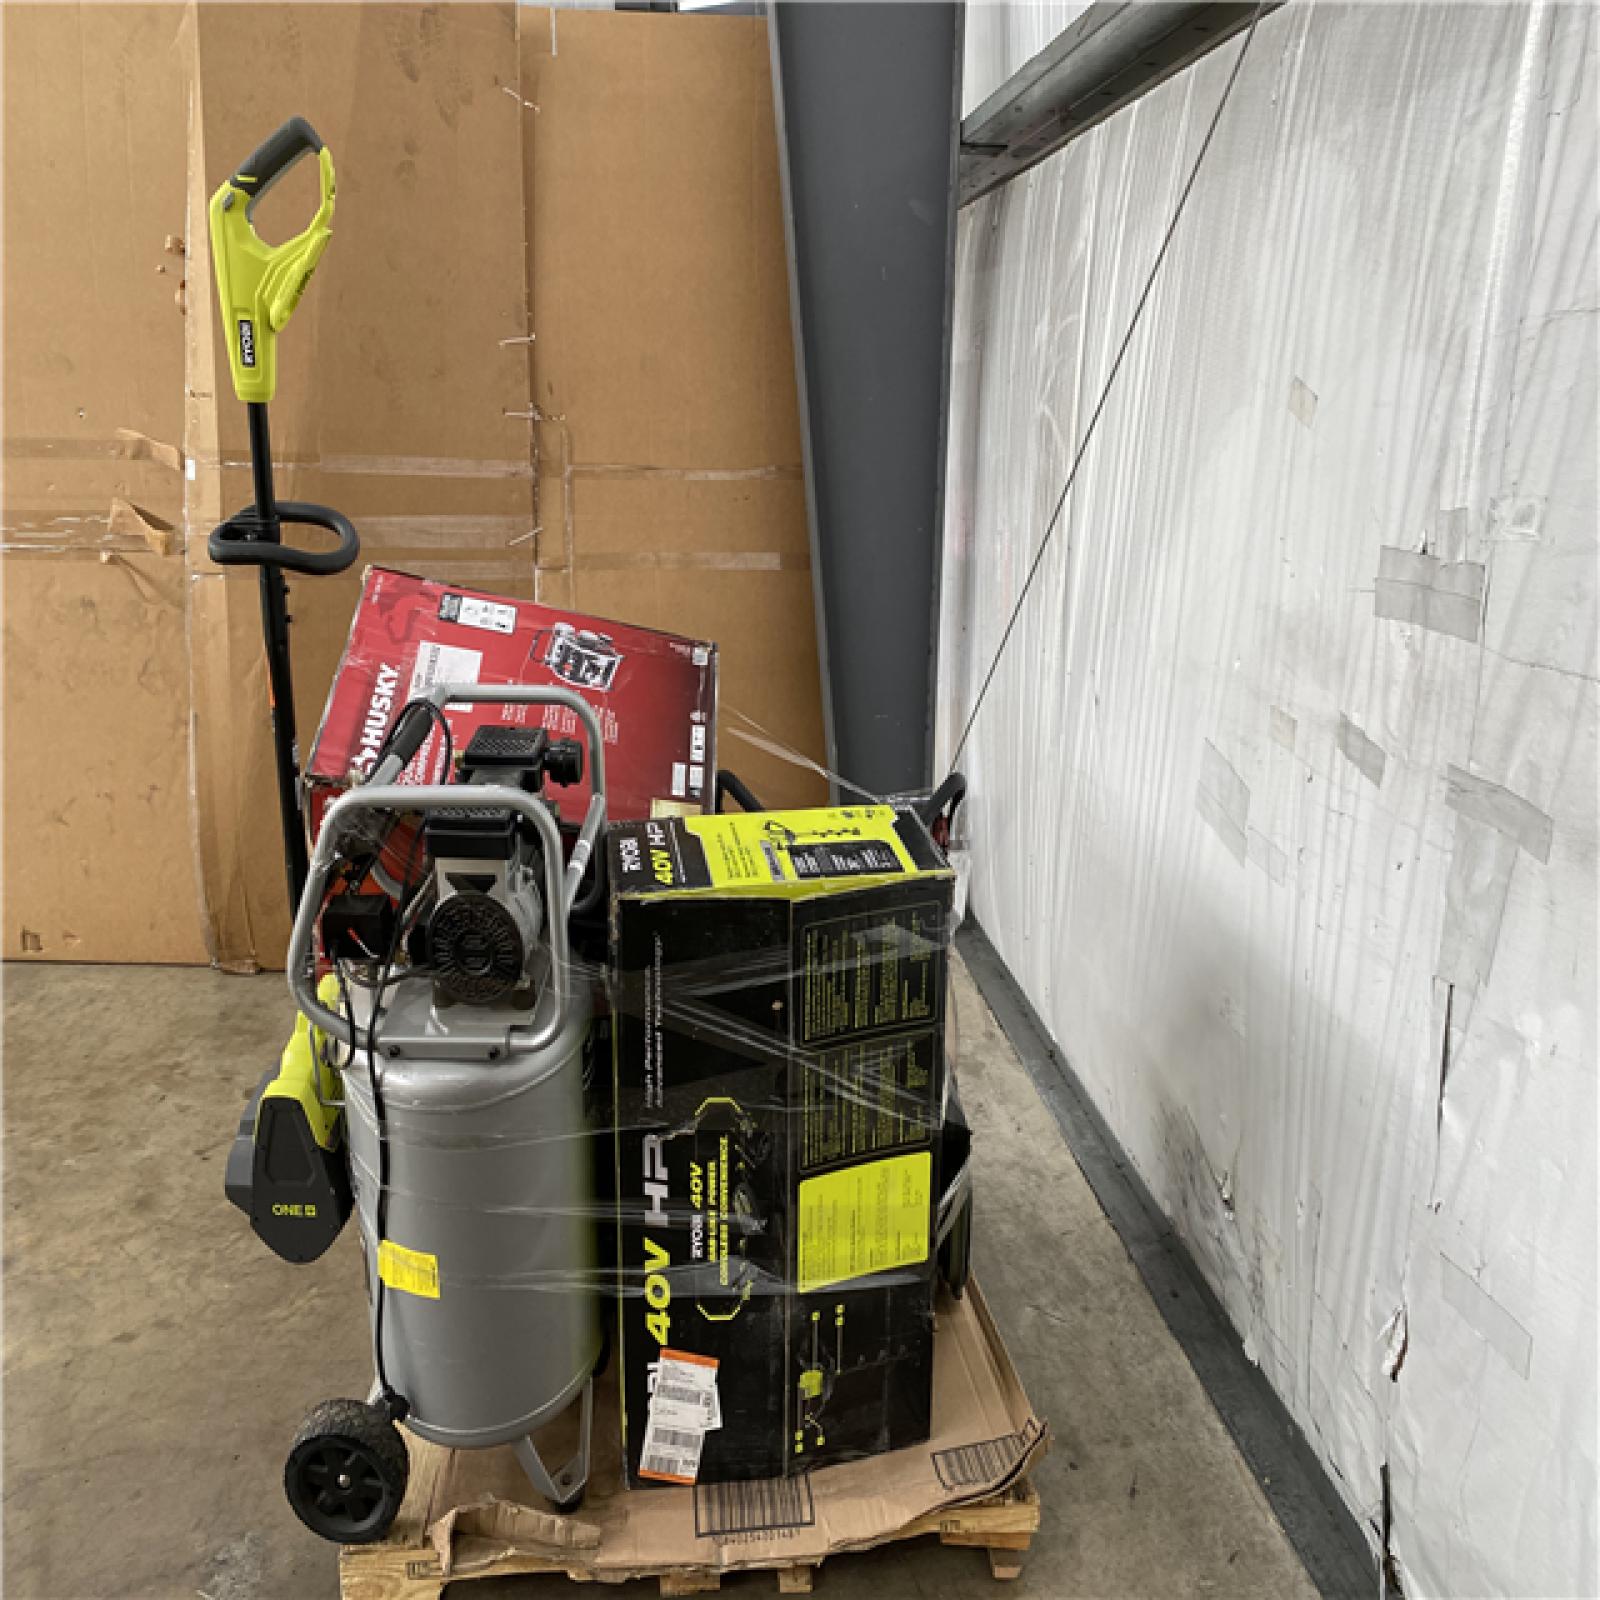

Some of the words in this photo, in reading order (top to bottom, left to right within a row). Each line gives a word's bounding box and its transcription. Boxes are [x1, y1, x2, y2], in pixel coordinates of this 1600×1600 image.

[361, 663, 398, 751] HUSKY
[646, 823, 666, 846] HP
[650, 849, 674, 885] 40V
[644, 1133, 669, 1227] HP
[690, 1162, 704, 1210] 40V
[644, 1237, 670, 1345] 40V
